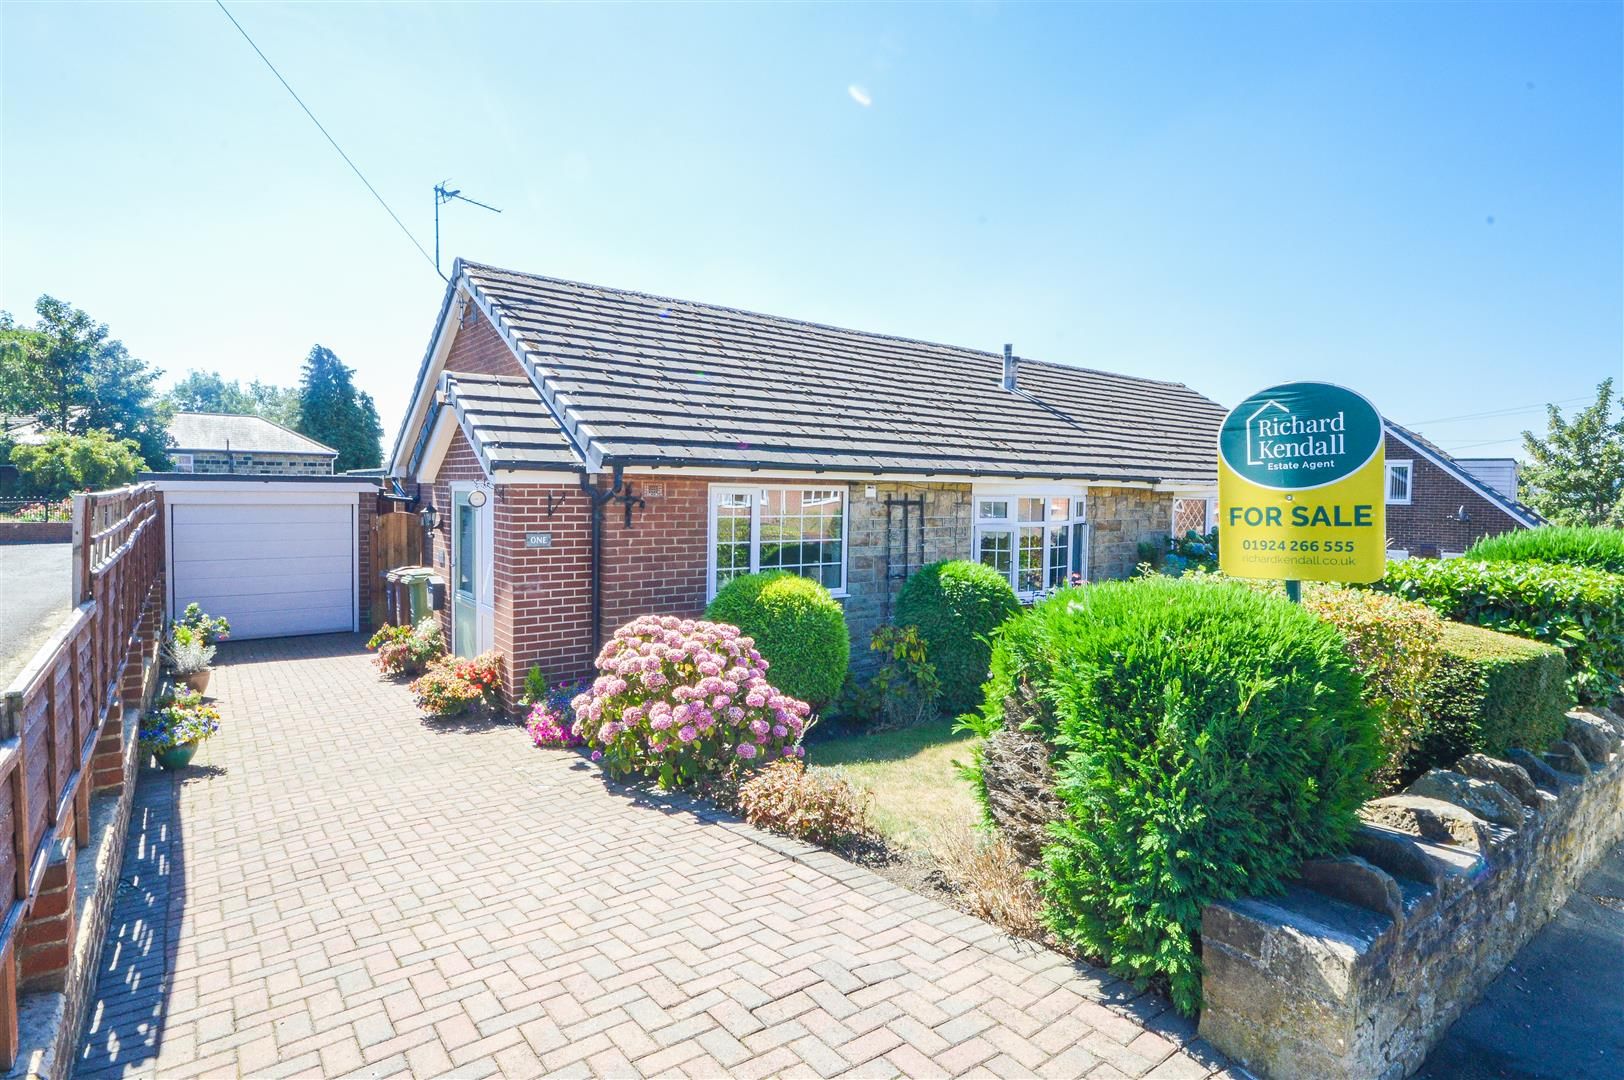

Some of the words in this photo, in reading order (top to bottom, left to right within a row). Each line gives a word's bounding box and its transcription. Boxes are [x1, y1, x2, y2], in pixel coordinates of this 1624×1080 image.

[1258, 411, 1346, 438] Richard
[1258, 434, 1346, 460] Kendall
[1268, 462, 1299, 470] Estate
[1302, 460, 1335, 470] Agent
[1230, 506, 1282, 527] FOR
[1292, 505, 1373, 527] SALE
[530, 536, 547, 544] ONE
[1242, 539, 1286, 551] 01924
[1290, 541, 1319, 552] 266
[1323, 541, 1355, 552] 555
[1242, 554, 1356, 566] richardkendall.co.uk
